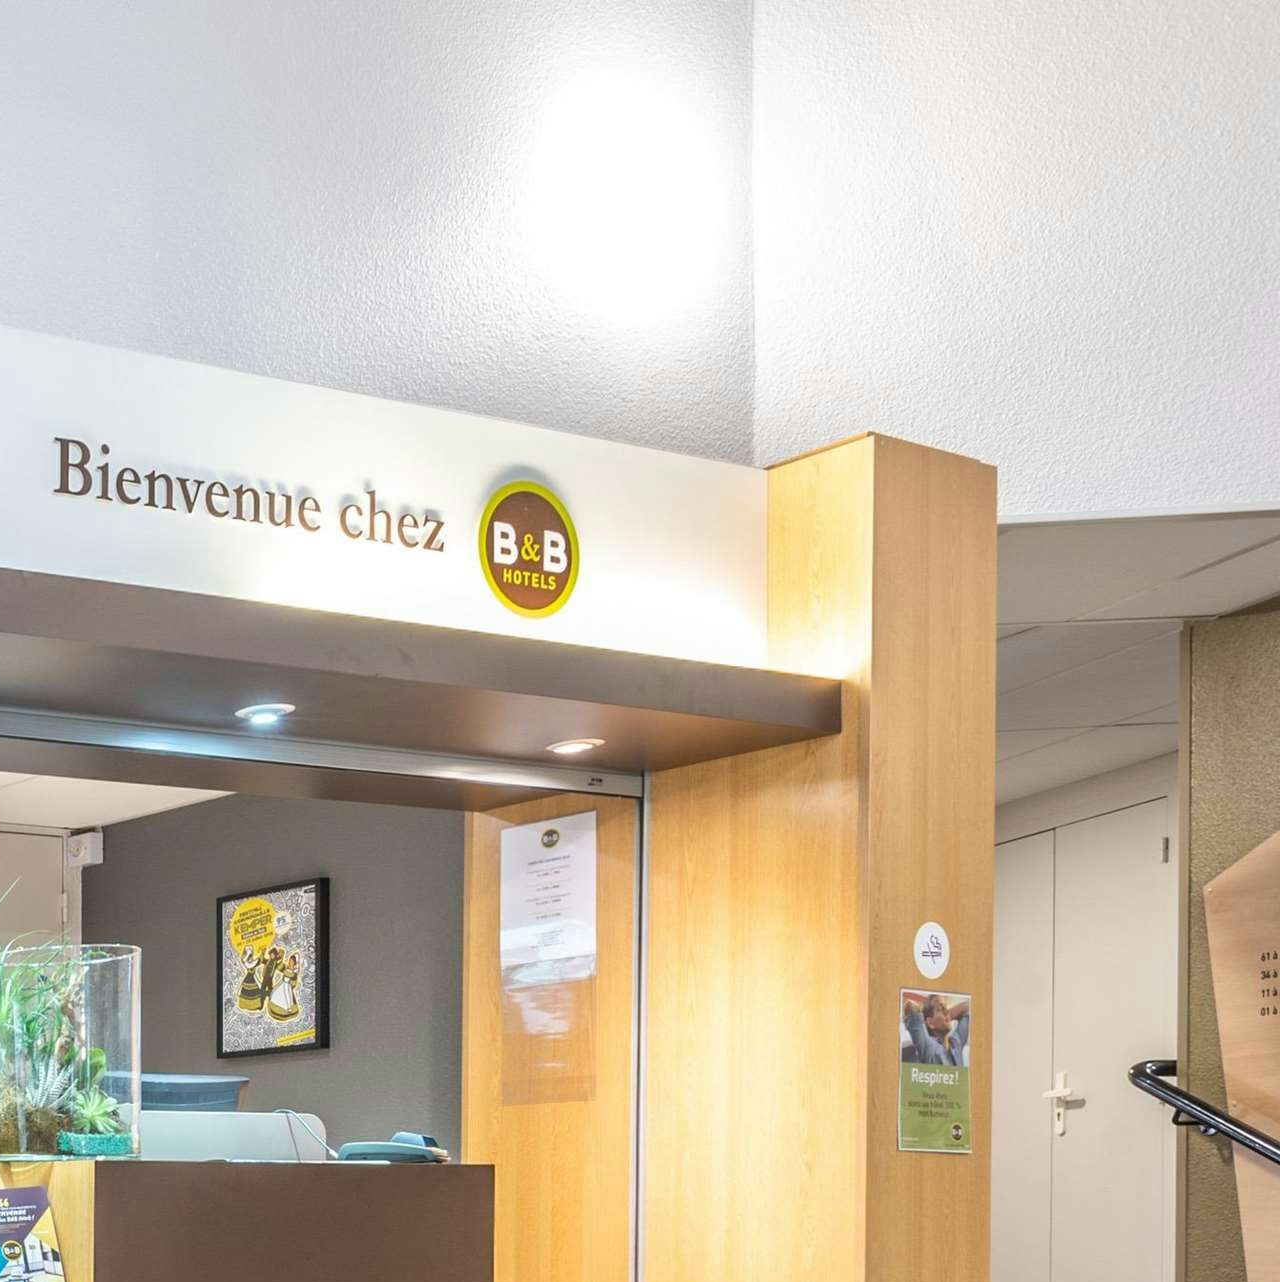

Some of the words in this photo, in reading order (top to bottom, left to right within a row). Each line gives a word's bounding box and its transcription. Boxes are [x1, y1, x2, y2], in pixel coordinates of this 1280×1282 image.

[52, 436, 322, 532] Bienvenue
[340, 483, 446, 552] chez
[493, 520, 568, 574] B&B
[503, 567, 557, 591] HOTELS
[1261, 988, 1271, 998] 11
